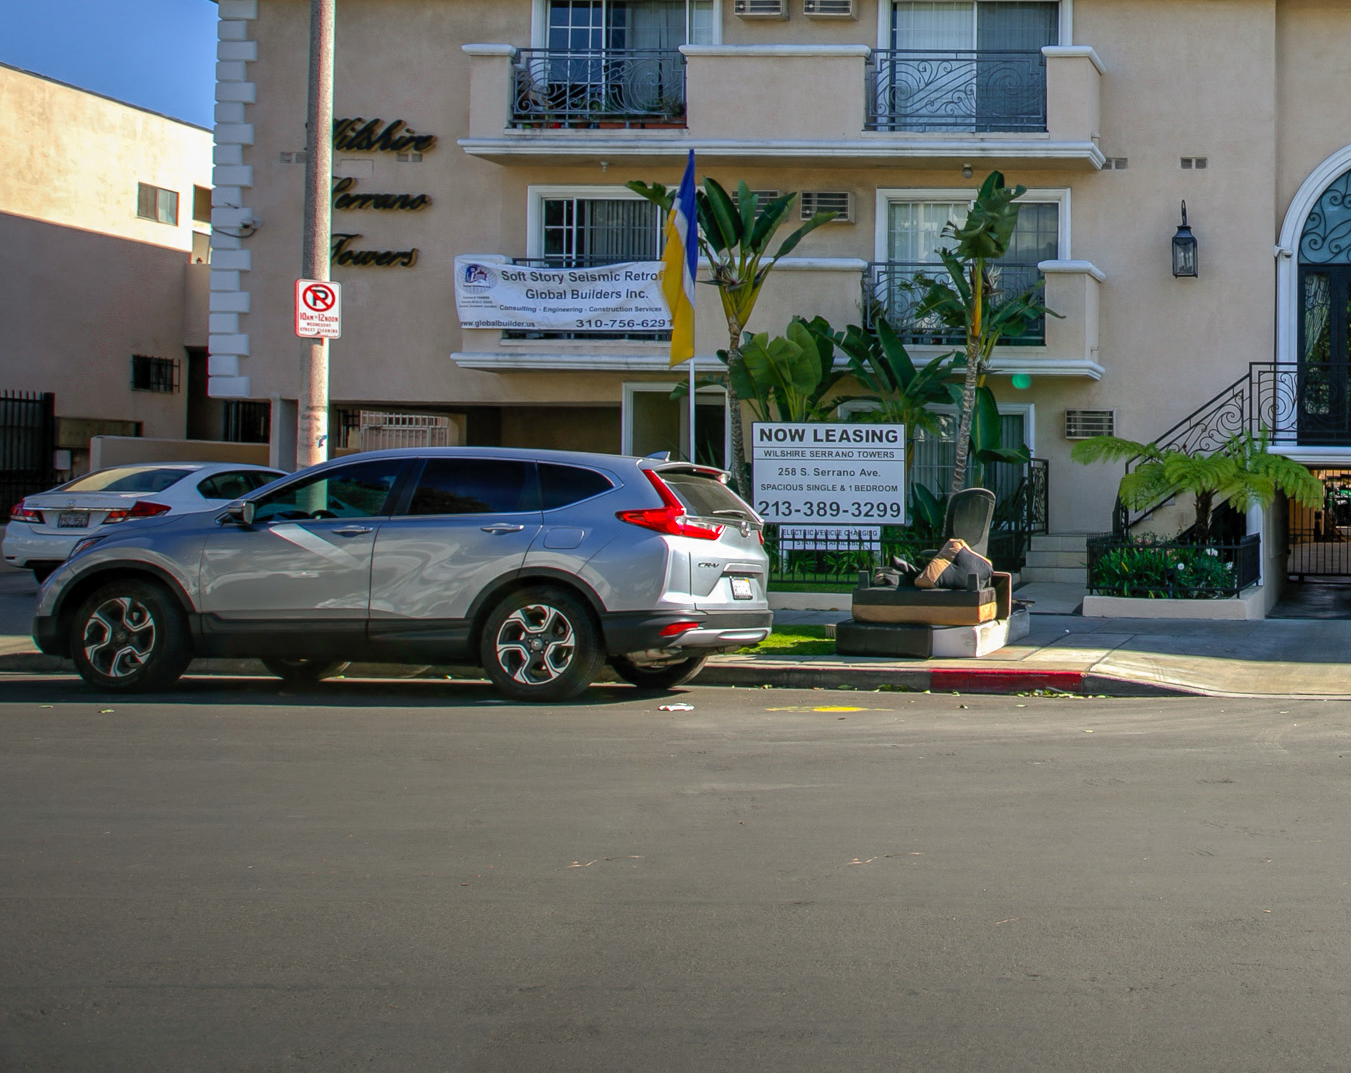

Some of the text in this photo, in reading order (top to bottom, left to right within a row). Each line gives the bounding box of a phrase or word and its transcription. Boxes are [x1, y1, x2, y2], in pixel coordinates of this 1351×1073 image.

[501, 270, 527, 282] Soft
[530, 271, 564, 284] Story
[569, 270, 620, 282] Seismic
[525, 288, 649, 300] Global Builders Inc.
[499, 304, 537, 313] Consulting
[543, 305, 583, 313] Engineering
[588, 305, 633, 313] Construction
[634, 305, 662, 313] Services
[575, 319, 674, 328] 310-756-6291
[759, 428, 898, 443] NOW LEASING
[763, 450, 895, 459] WILSHIRE SERRANO TOWERS
[777, 467, 881, 477] 258 S. Serrano Ave.
[806, 484, 837, 492] SINGLE
[855, 484, 898, 492] BEDROOM
[758, 500, 901, 518] 213-389-3299
